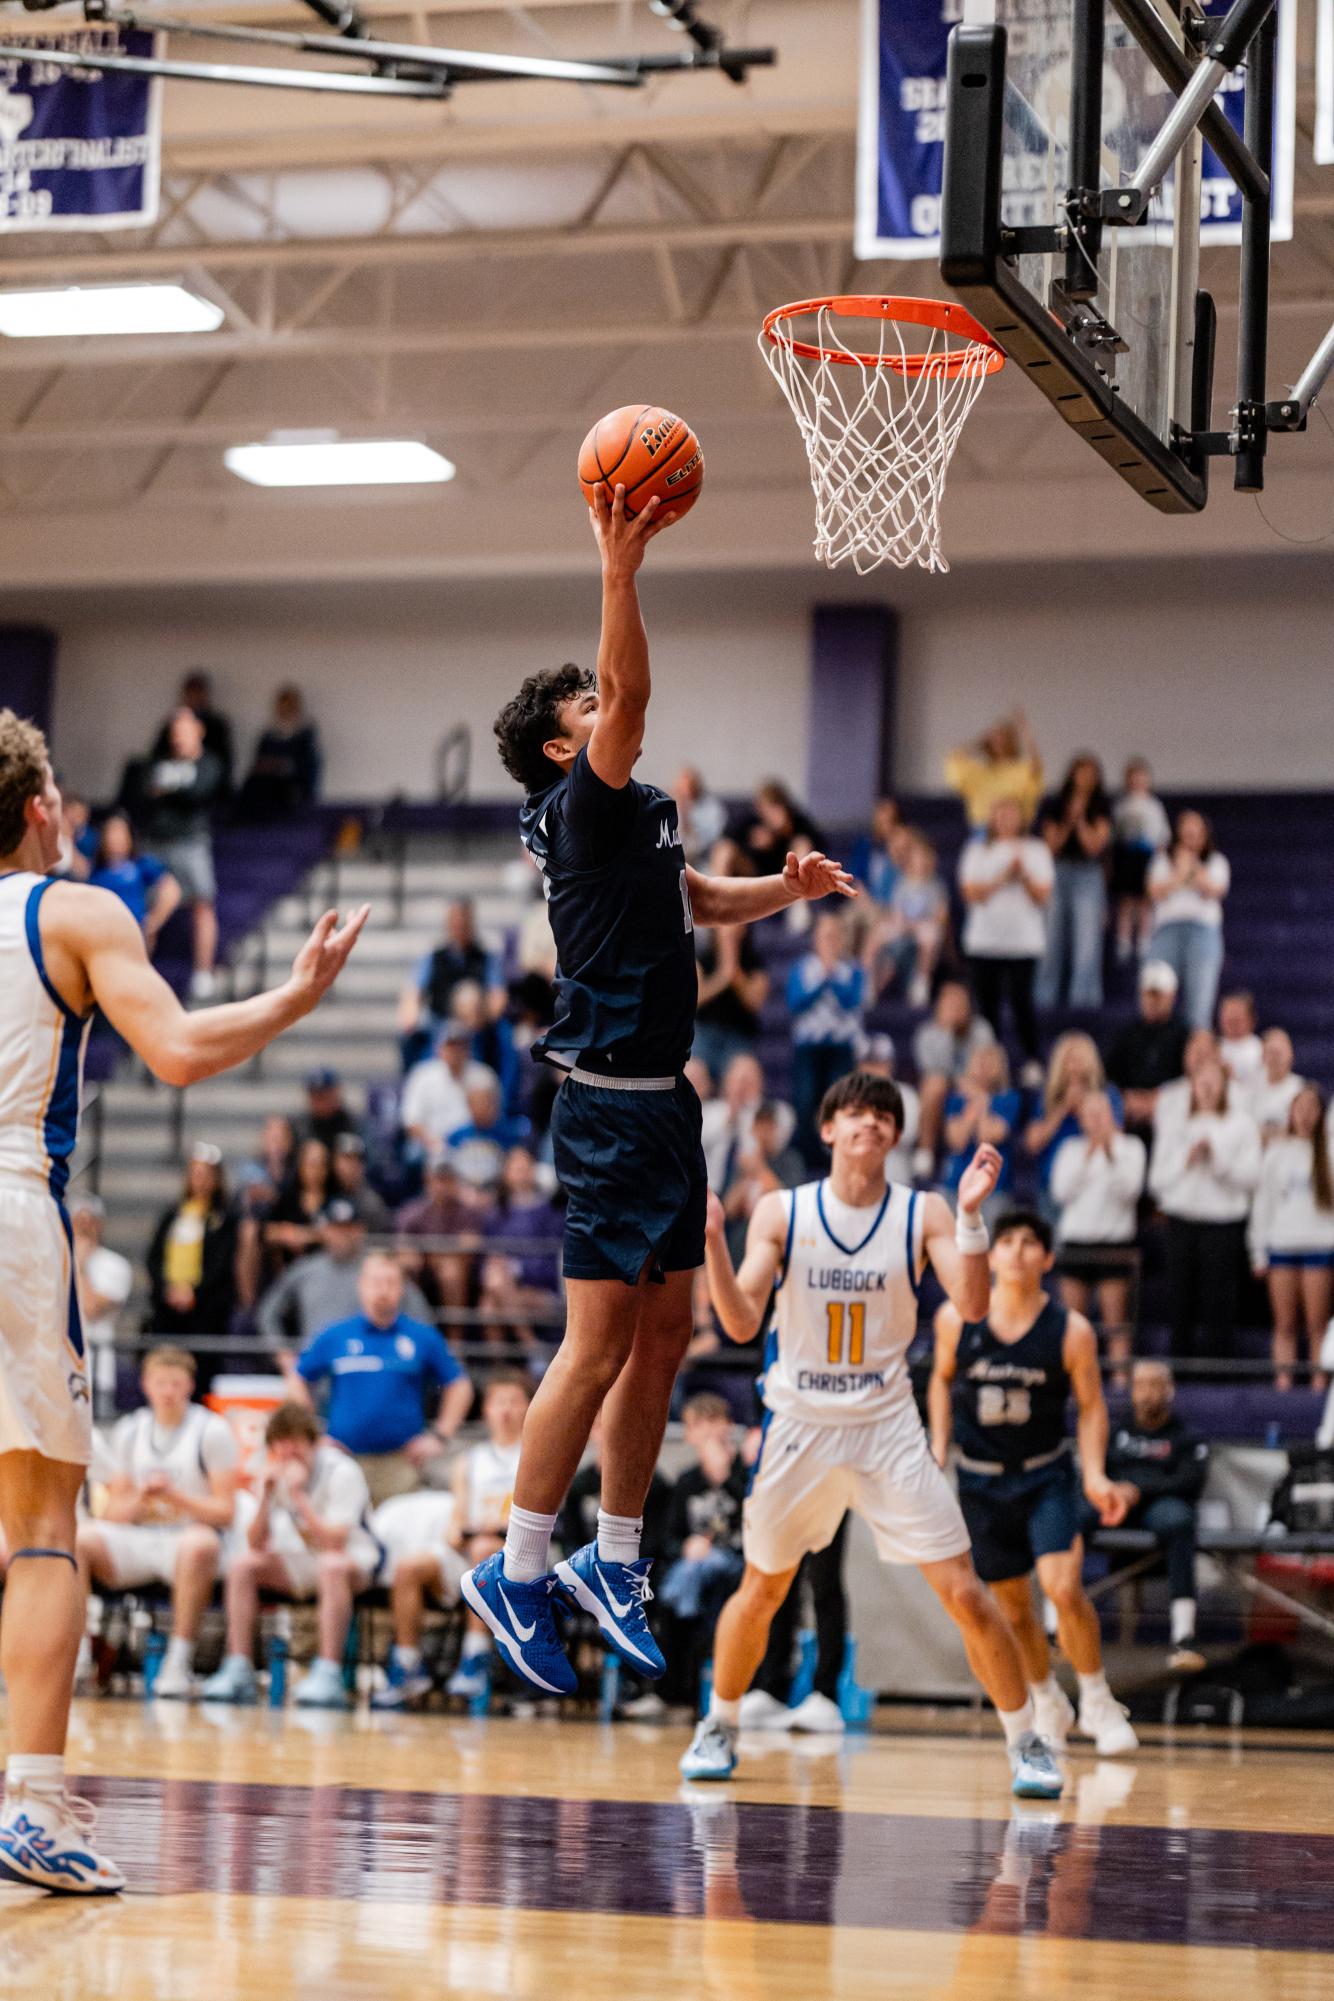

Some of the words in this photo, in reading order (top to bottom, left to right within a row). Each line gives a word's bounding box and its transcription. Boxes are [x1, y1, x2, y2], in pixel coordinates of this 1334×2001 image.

[808, 1268, 887, 1292] LUBBOCK
[826, 1301, 865, 1366] 11
[798, 1370, 884, 1393] CHRISTIAN
